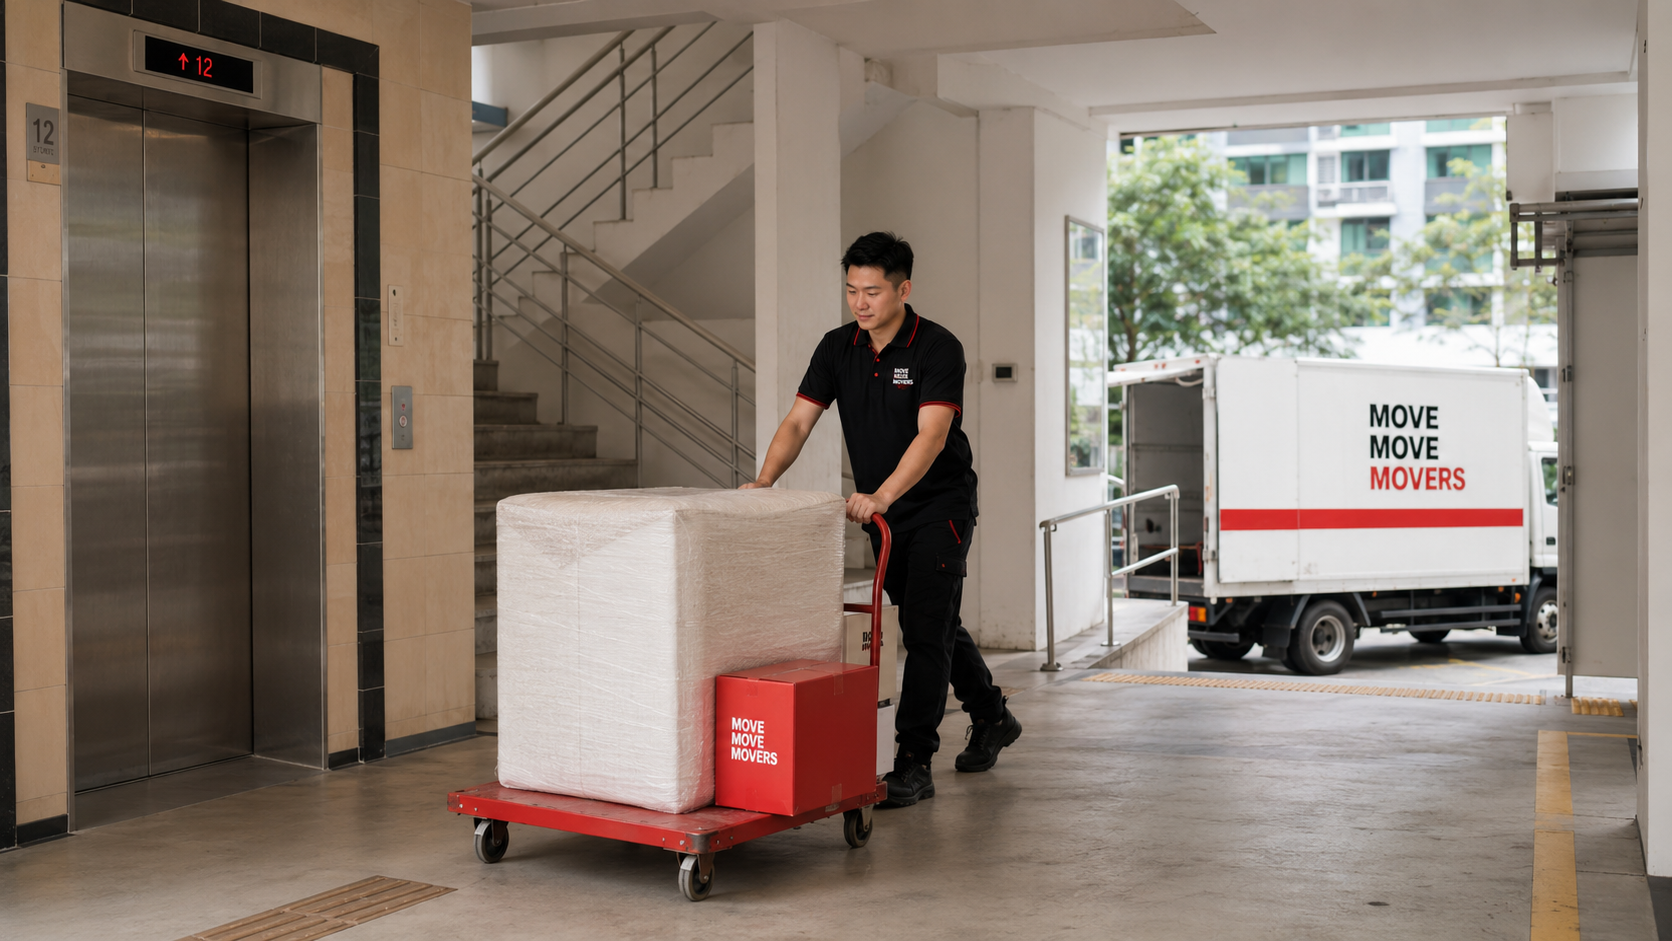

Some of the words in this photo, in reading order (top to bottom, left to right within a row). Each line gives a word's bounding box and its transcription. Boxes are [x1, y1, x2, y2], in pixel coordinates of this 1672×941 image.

[196, 55, 213, 78] 12
[33, 118, 54, 146] 12
[1369, 403, 1439, 430] MOVE
[1370, 434, 1439, 460] MOVE
[1370, 465, 1466, 491] MOVERS
[731, 716, 765, 734] MOVE
[731, 731, 765, 749] MOVE
[731, 746, 778, 766] MOVERS
